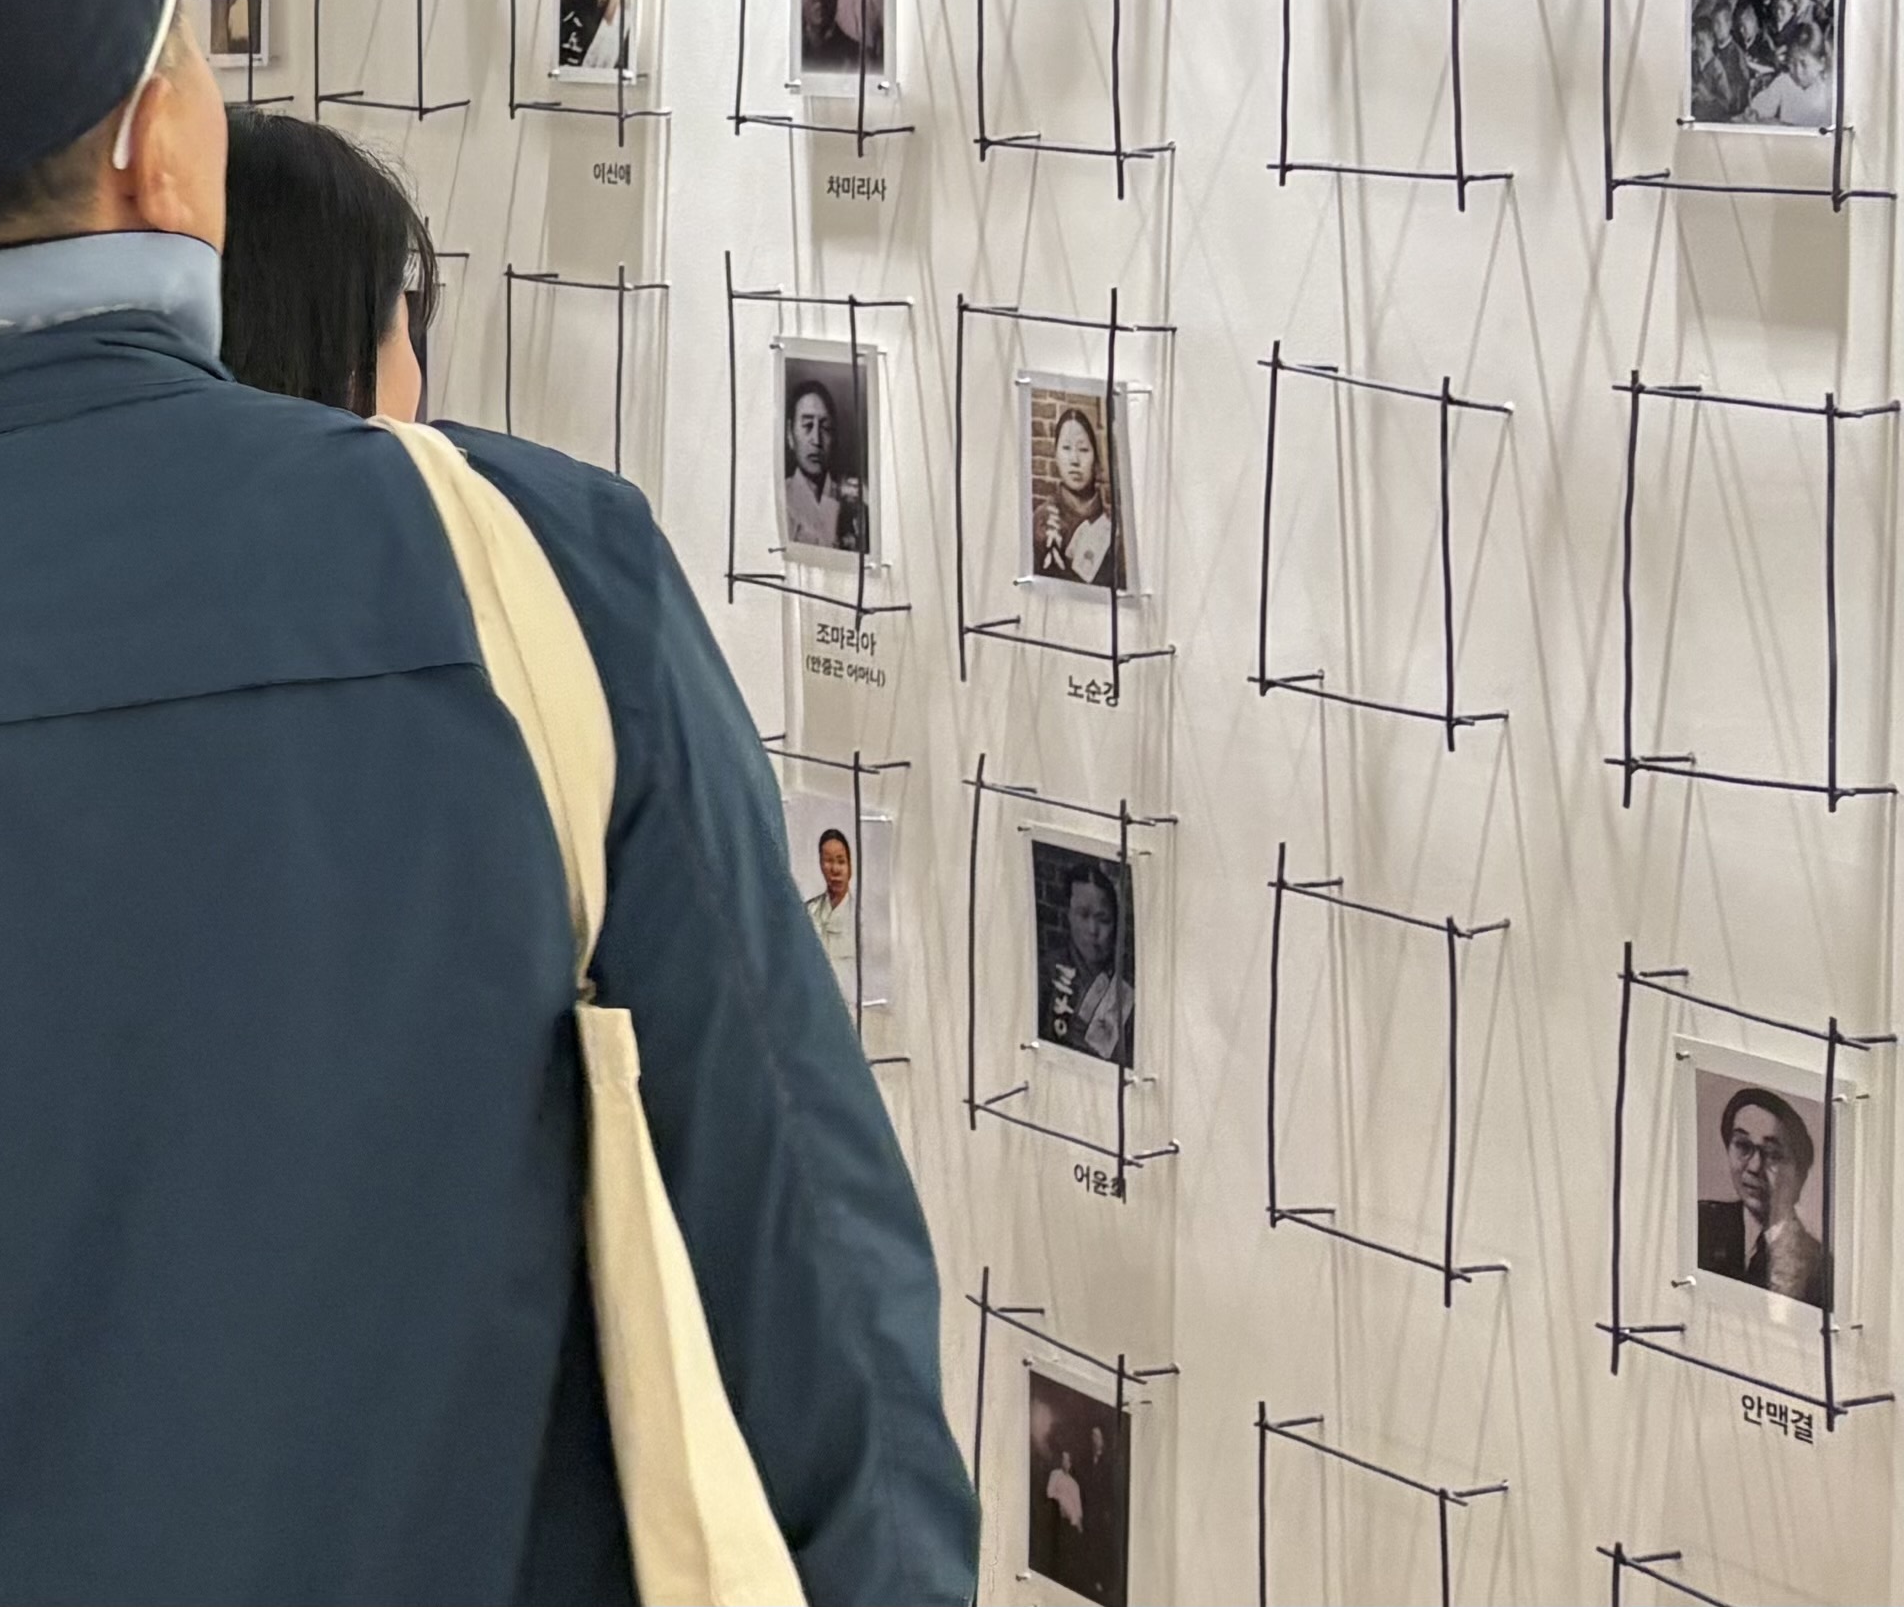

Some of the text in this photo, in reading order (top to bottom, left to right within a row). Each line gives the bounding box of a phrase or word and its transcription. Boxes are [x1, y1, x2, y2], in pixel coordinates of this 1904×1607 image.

[827, 175, 887, 202] 차미리사
[816, 623, 877, 656] 조마리아
[806, 654, 886, 687] (안중근 어머니)
[1742, 1395, 1813, 1444] 안맥결
